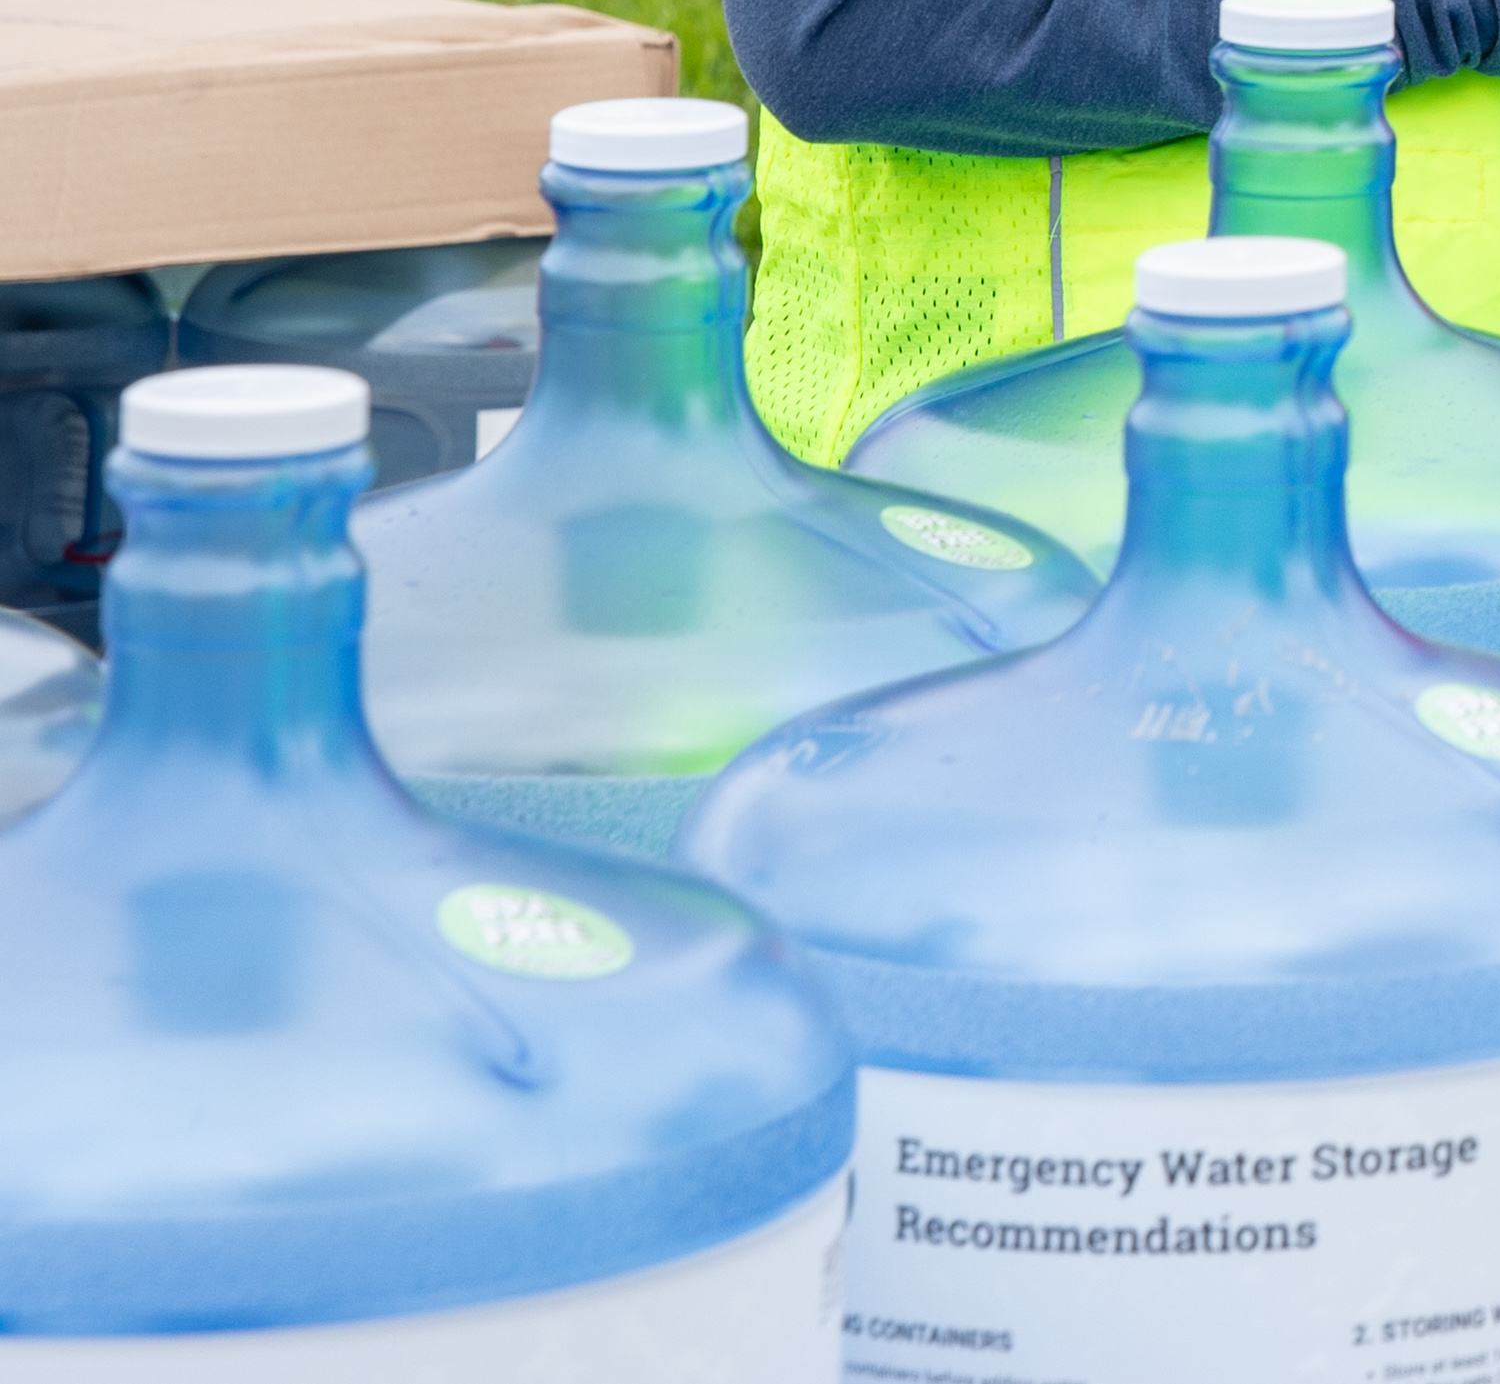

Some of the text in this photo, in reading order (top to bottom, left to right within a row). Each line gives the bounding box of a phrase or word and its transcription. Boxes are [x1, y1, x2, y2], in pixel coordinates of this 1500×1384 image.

[897, 1137, 1478, 1196] Emergency Water Storage
[896, 1205, 1316, 1254] Recommendations
[868, 1318, 1012, 1351] CONTAINERS
[1354, 1325, 1377, 1345] 2.
[1383, 1309, 1485, 1341] STORING
